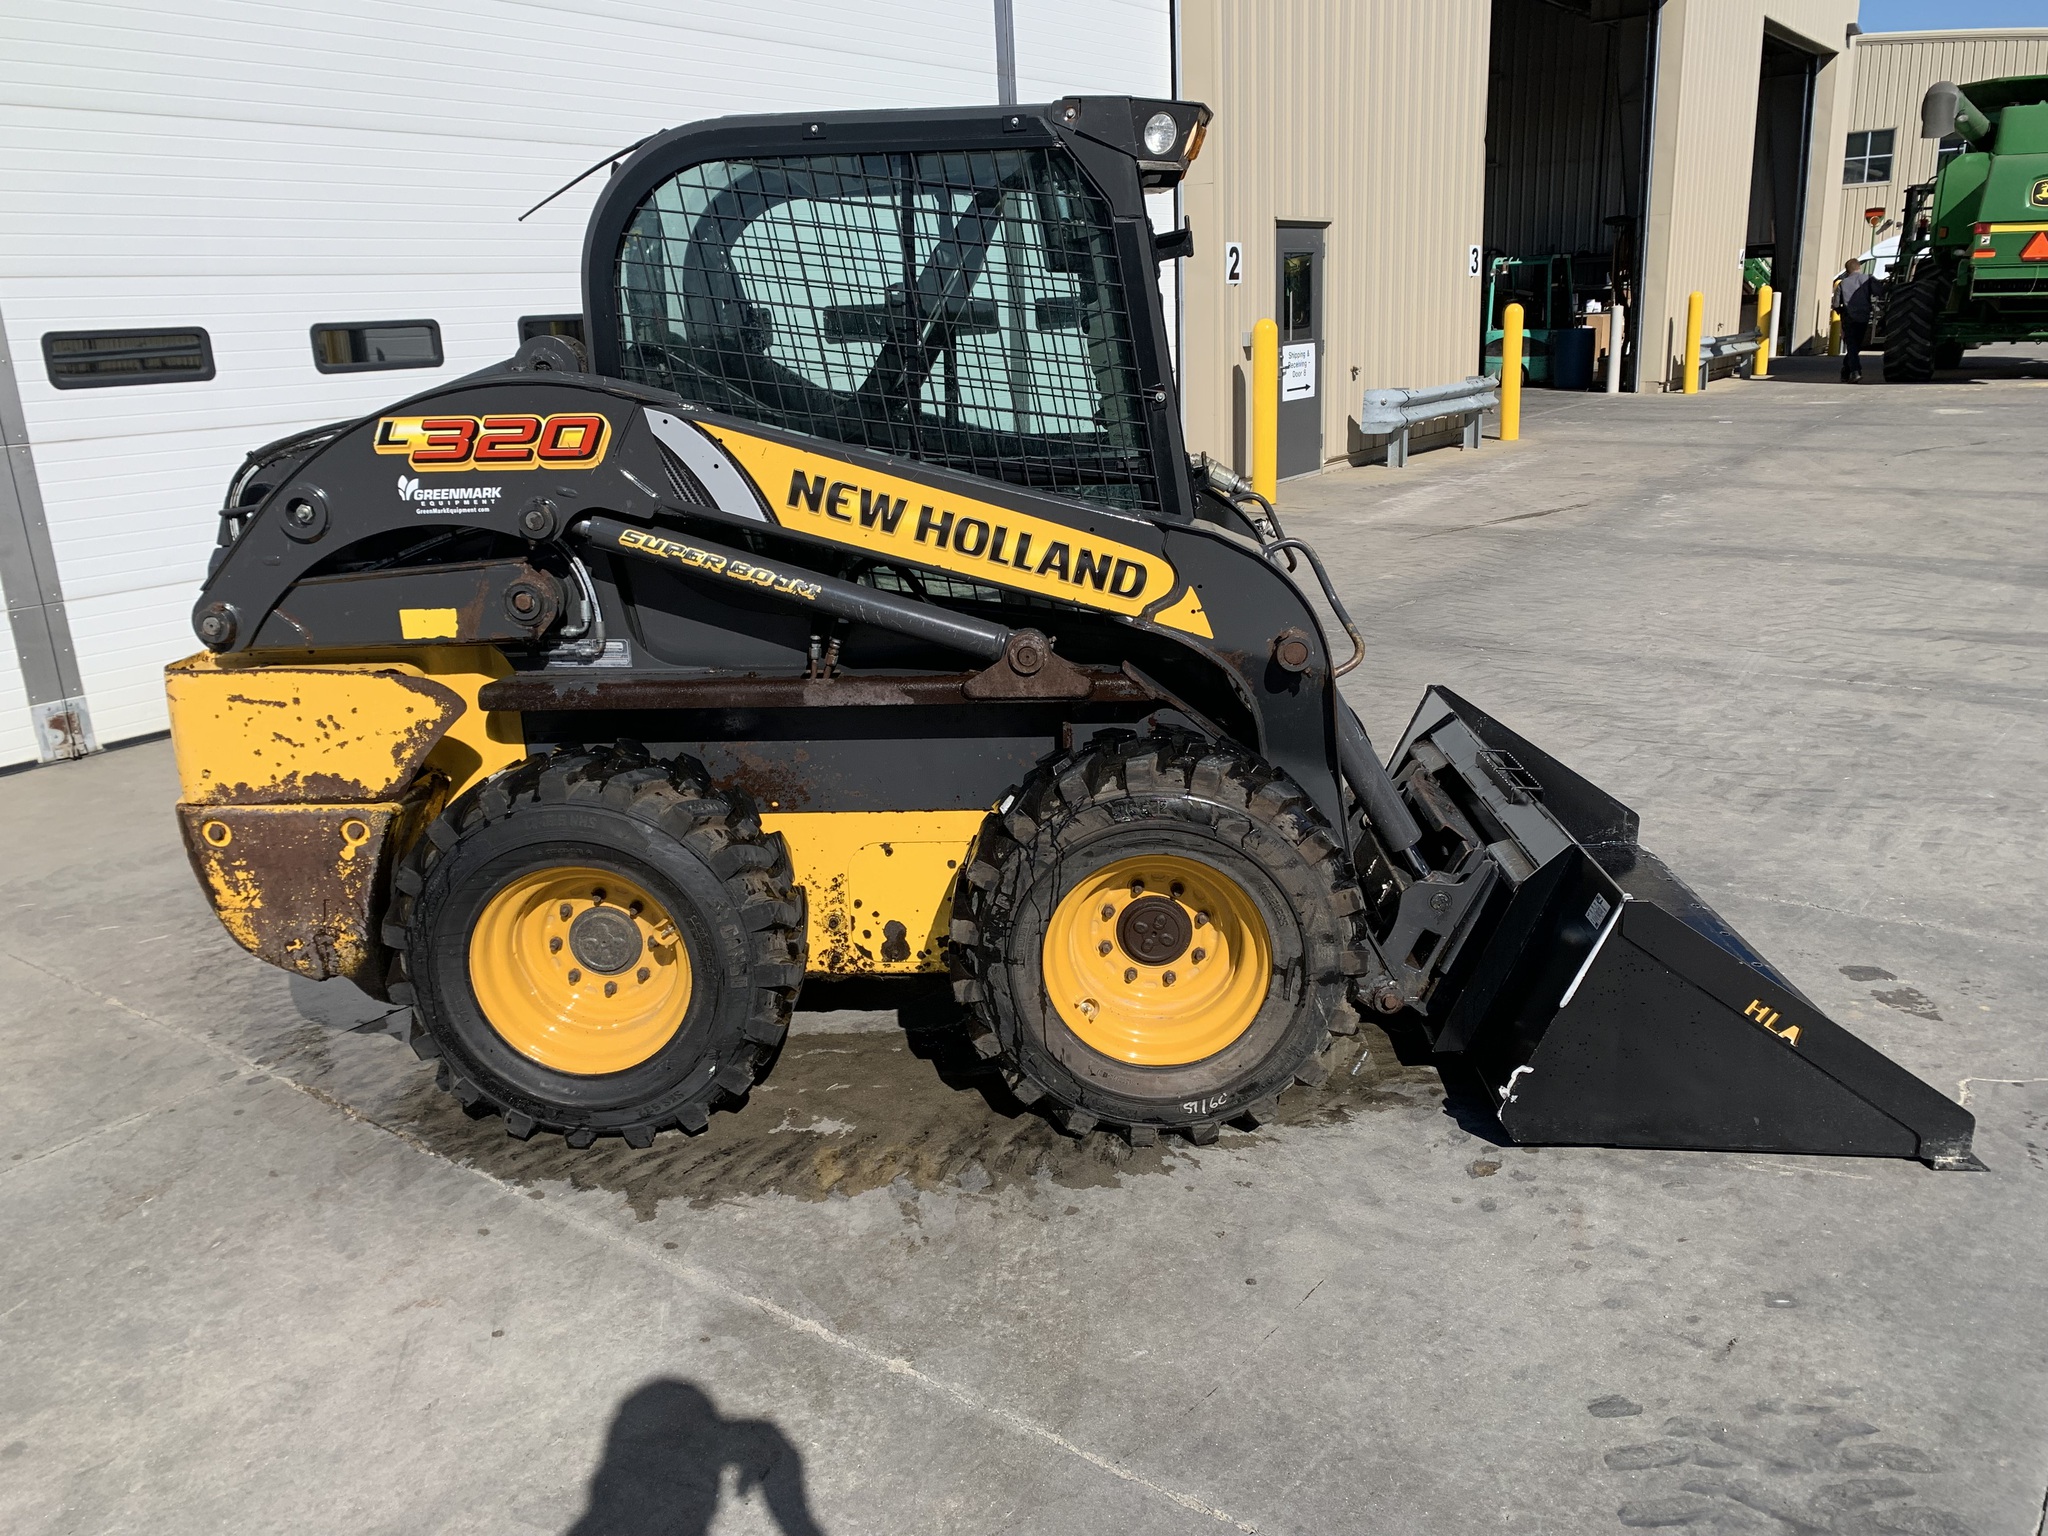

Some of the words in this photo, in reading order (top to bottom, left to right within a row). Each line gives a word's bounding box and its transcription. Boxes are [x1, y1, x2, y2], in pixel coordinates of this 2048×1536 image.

[1228, 246, 1240, 281] 2
[1470, 247, 1480, 274] 3
[1288, 351, 1306, 359] Shipping
[1288, 360, 1307, 369] Receiving
[1292, 370, 1302, 378] Door
[413, 486, 502, 501] GREENMARK
[420, 499, 496, 507] EQUIPMENT
[785, 467, 909, 534] NEW
[913, 504, 1149, 599] HOLLAND
[619, 529, 726, 573] SUPER
[1744, 998, 1804, 1048] HLA
